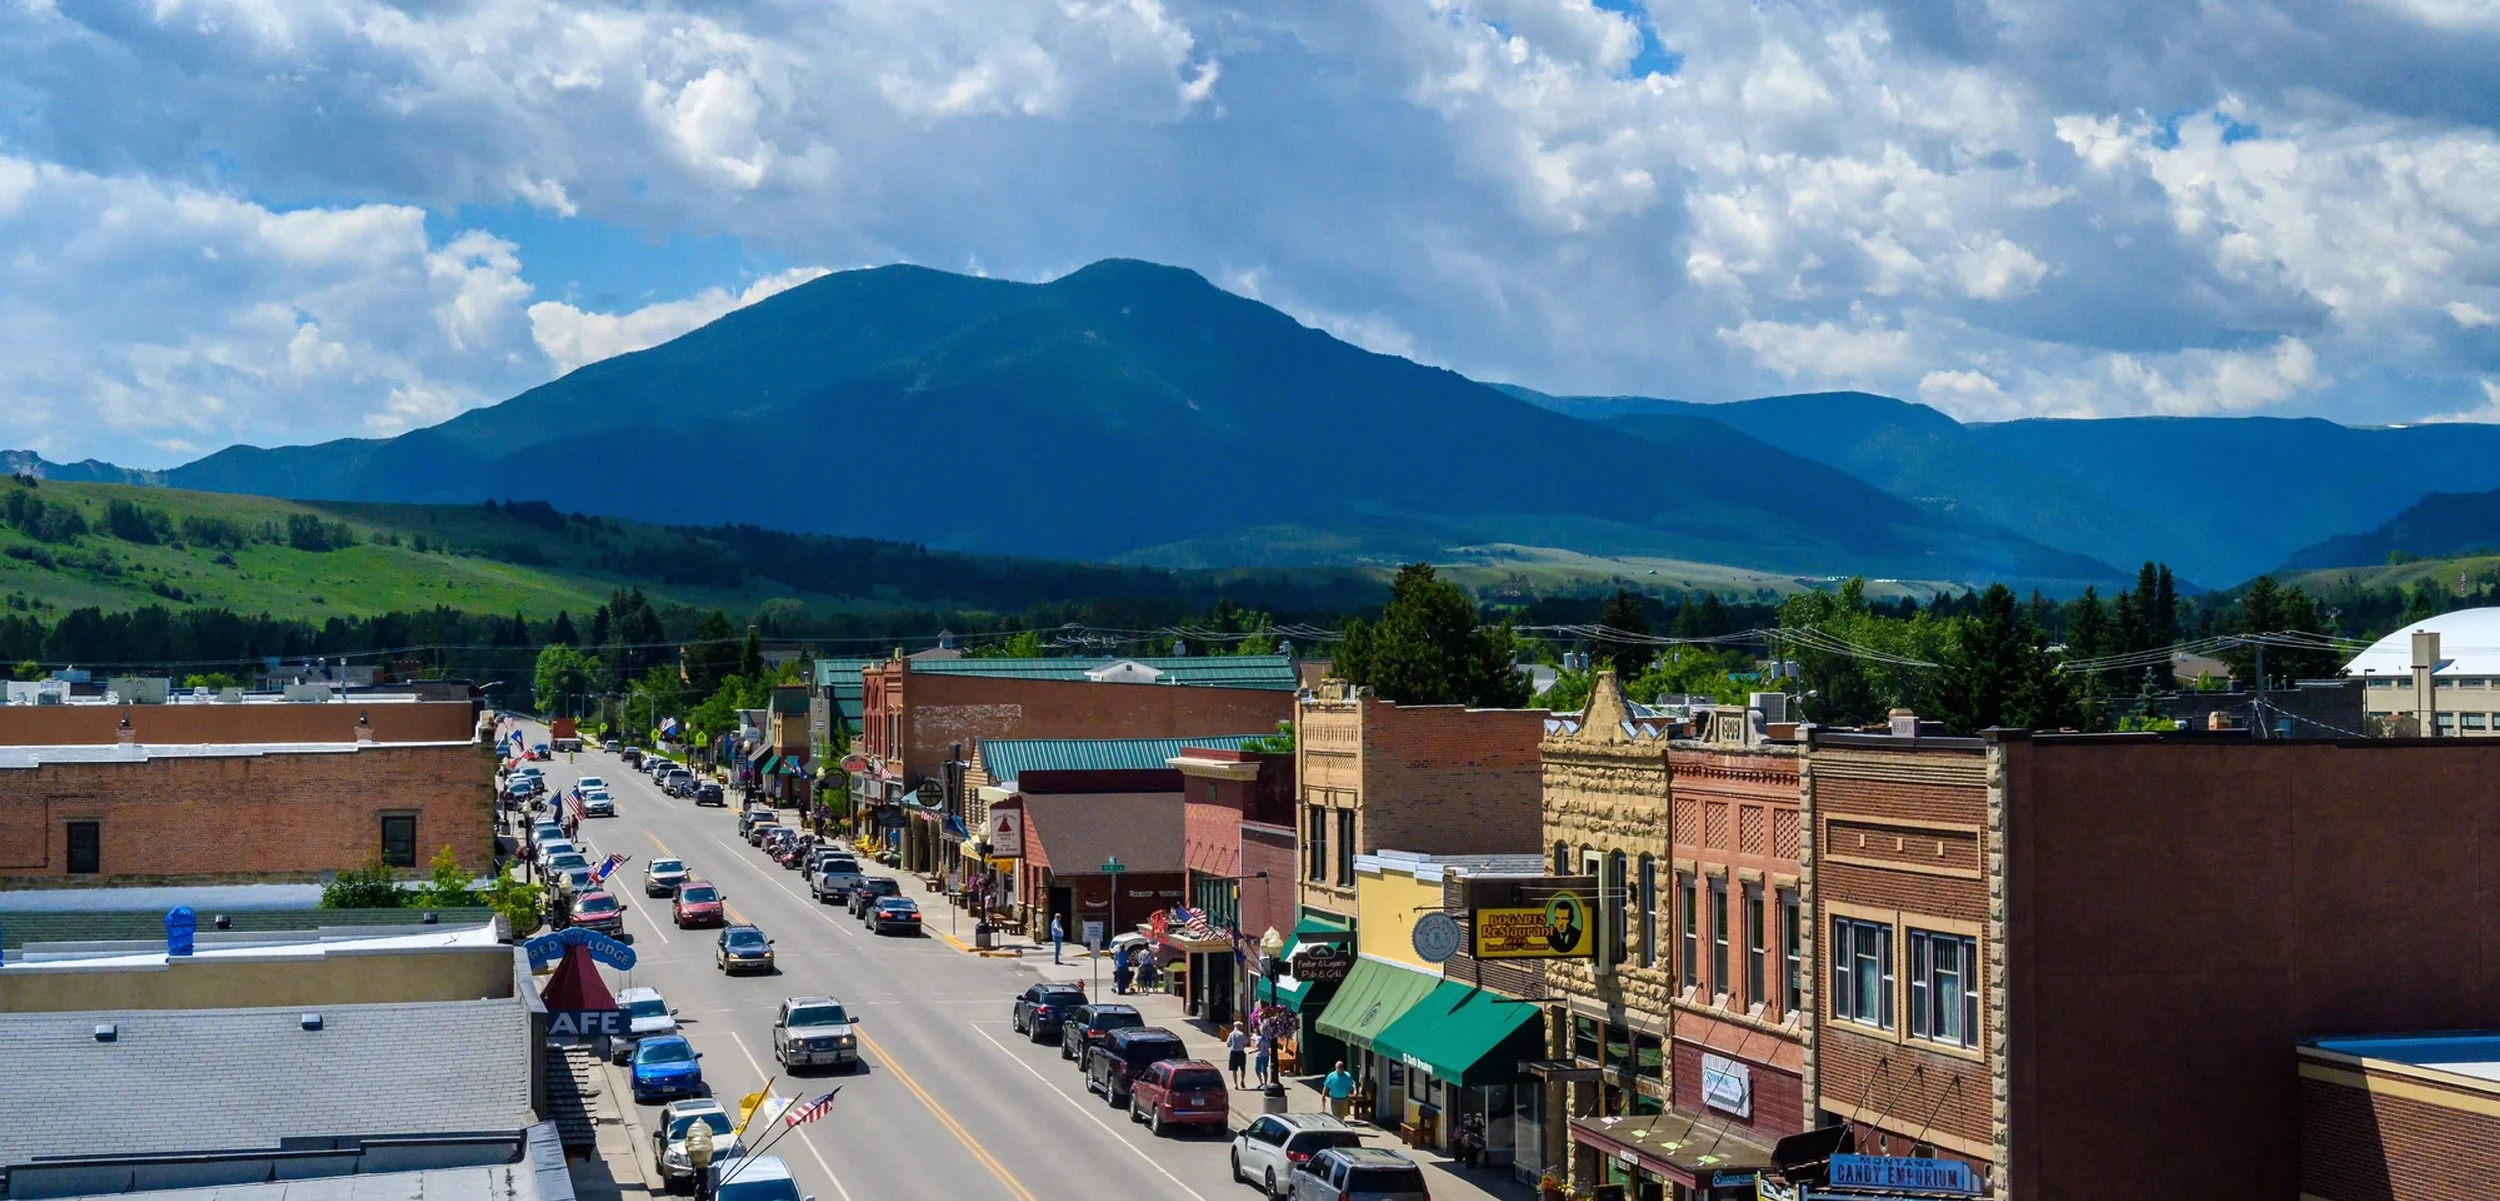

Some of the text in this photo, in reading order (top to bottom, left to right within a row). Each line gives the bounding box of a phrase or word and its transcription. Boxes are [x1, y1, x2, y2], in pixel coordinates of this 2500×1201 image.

[1489, 913, 1546, 925] BOGARTS
[1481, 924, 1554, 938] Restaurant
[528, 940, 629, 965] RED LODGE
[1301, 970, 1317, 978] Pub
[548, 1012, 620, 1035] AFE
[1859, 1157, 1934, 1168] MONTANA
[1837, 1164, 1958, 1188] CANDY EMPORIUM
